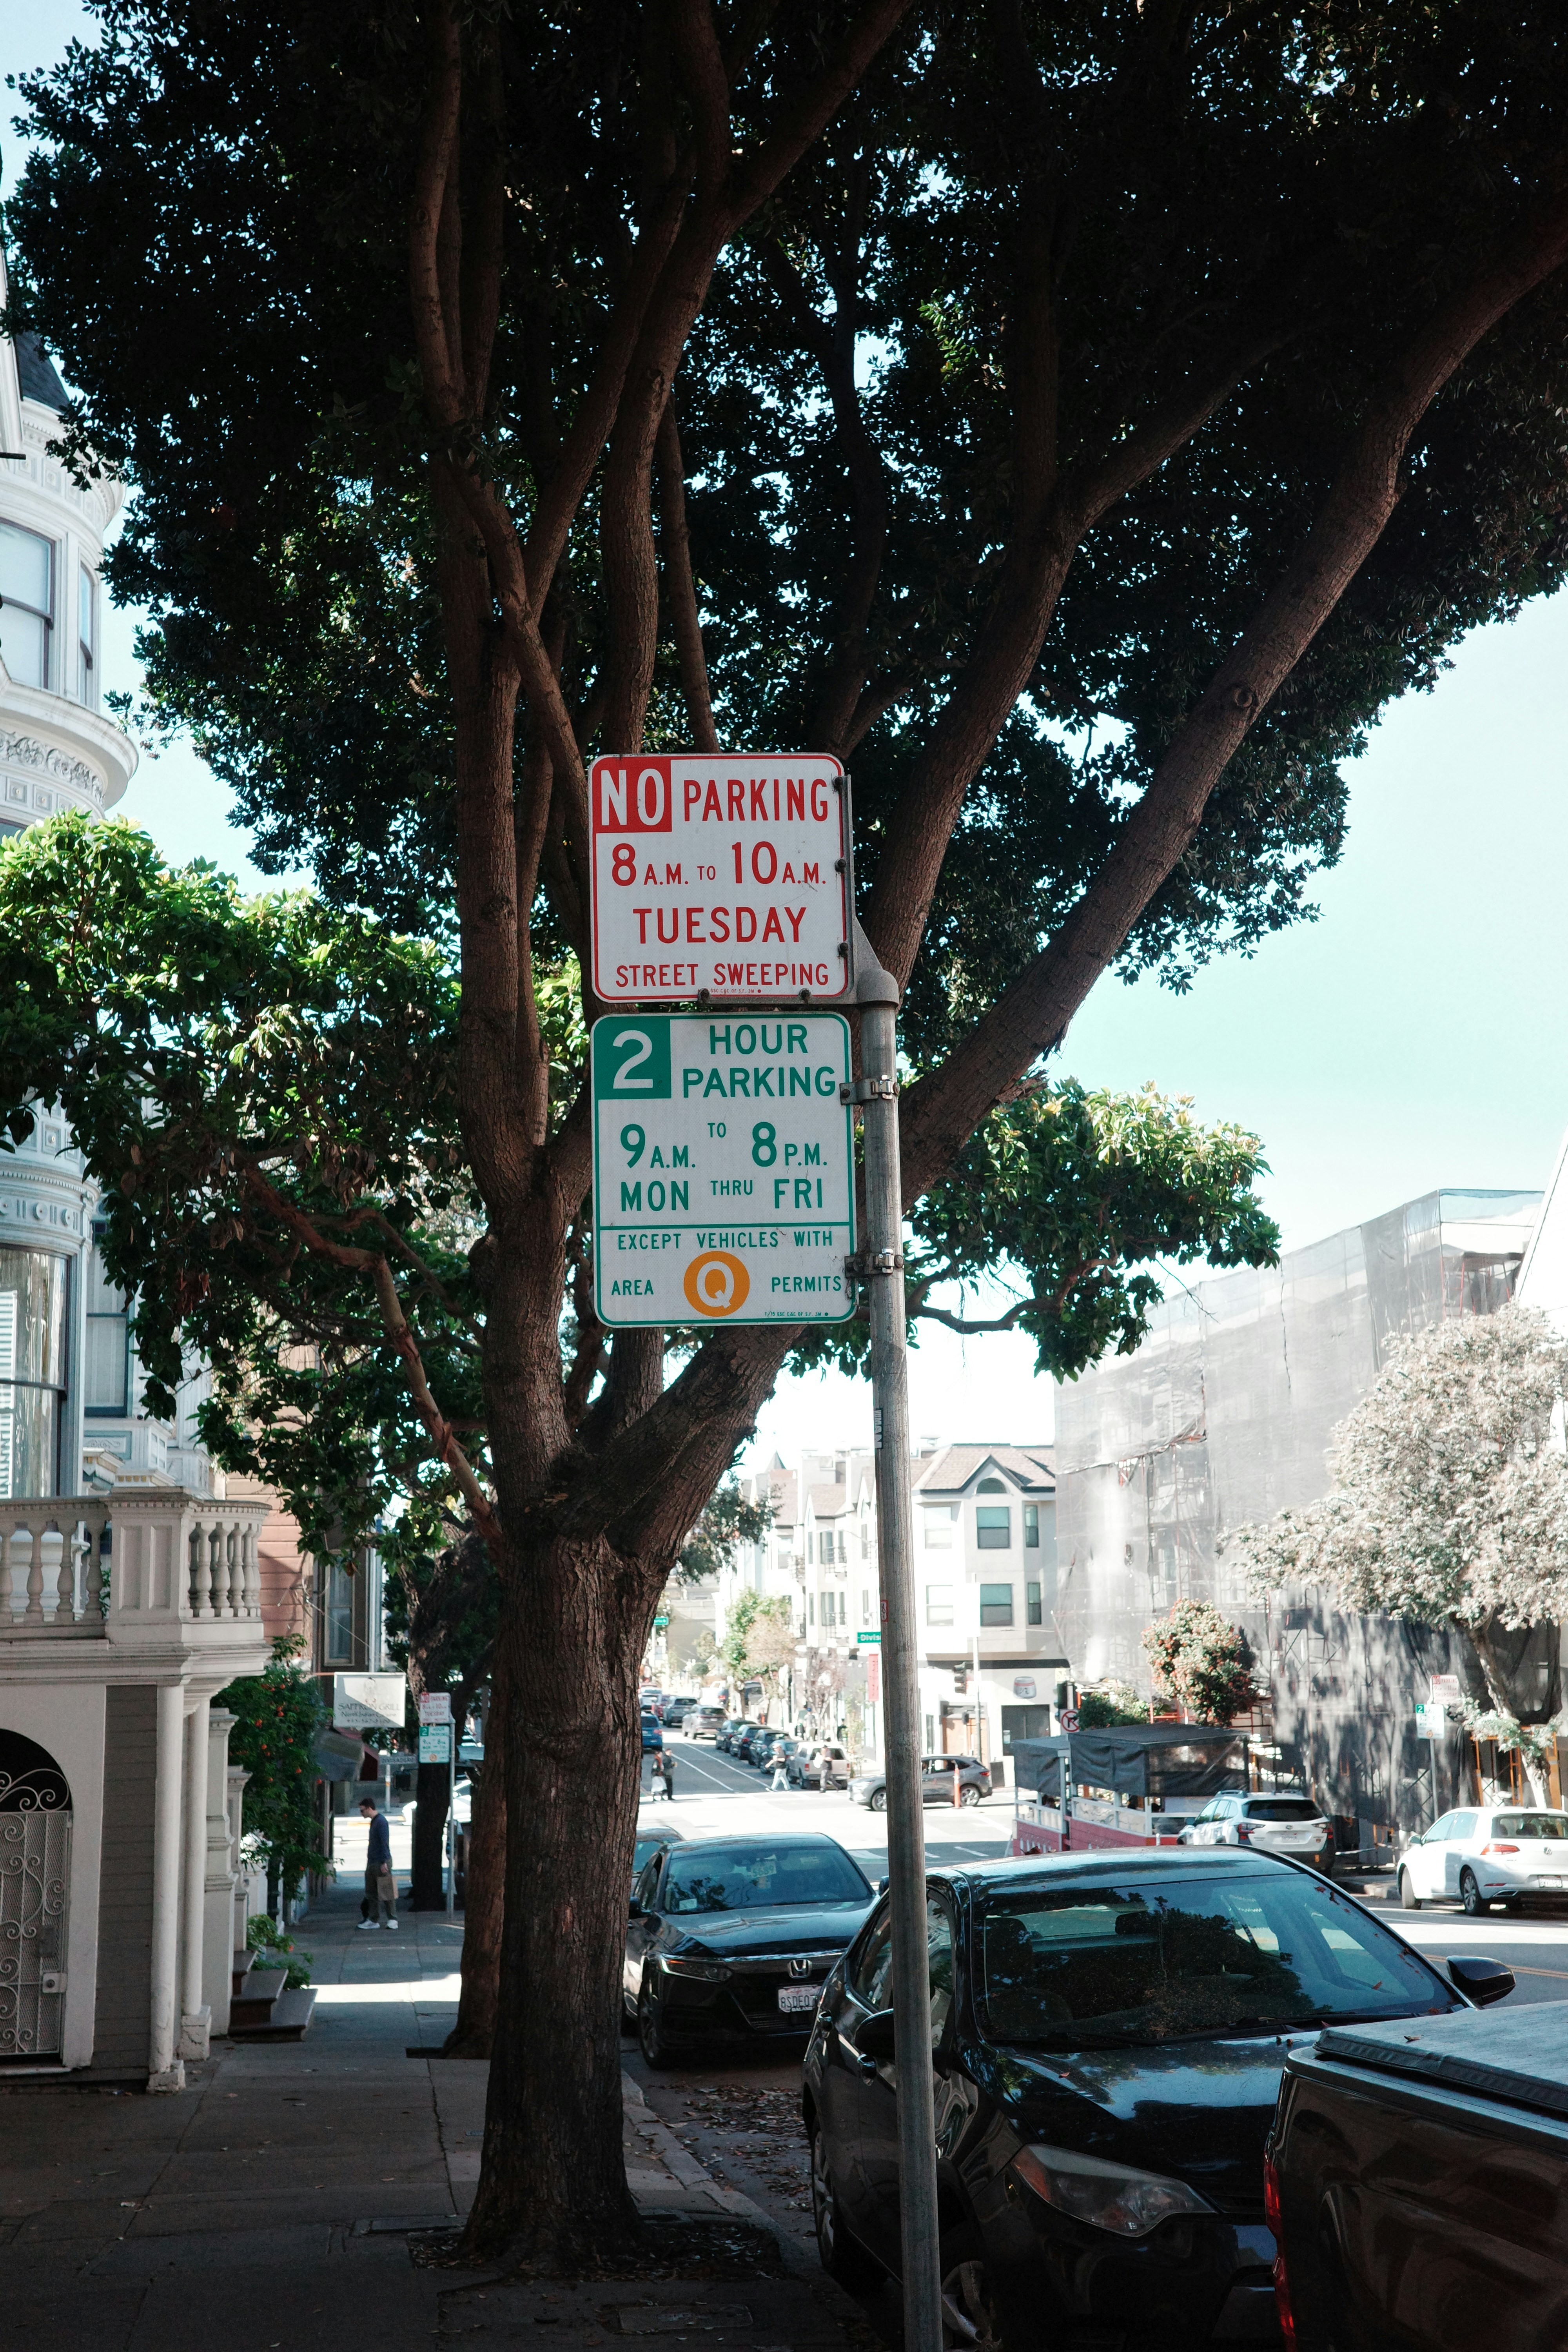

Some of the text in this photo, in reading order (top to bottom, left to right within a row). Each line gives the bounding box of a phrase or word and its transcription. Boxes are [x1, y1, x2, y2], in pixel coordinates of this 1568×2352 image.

[601, 769, 829, 826] NO PARKING
[612, 841, 826, 887] 8 A.M. TO 10 A.M.
[633, 907, 807, 944] TUESDAY
[616, 963, 829, 988] STREET SWEEPING
[710, 1024, 808, 1055] HOUR
[613, 1030, 654, 1089] 2
[683, 1066, 836, 1099] PARKING
[620, 1122, 828, 1169] 9 A.M. TO 8 P.M.
[621, 1178, 823, 1212] MON THRU FRI
[618, 1230, 833, 1251] EXCEPT VEHICLES WITH
[611, 1261, 842, 1309] AREA Q PERMITS
[422, 1728, 428, 1736] 2
[780, 1994, 816, 2008] 8SDE07
